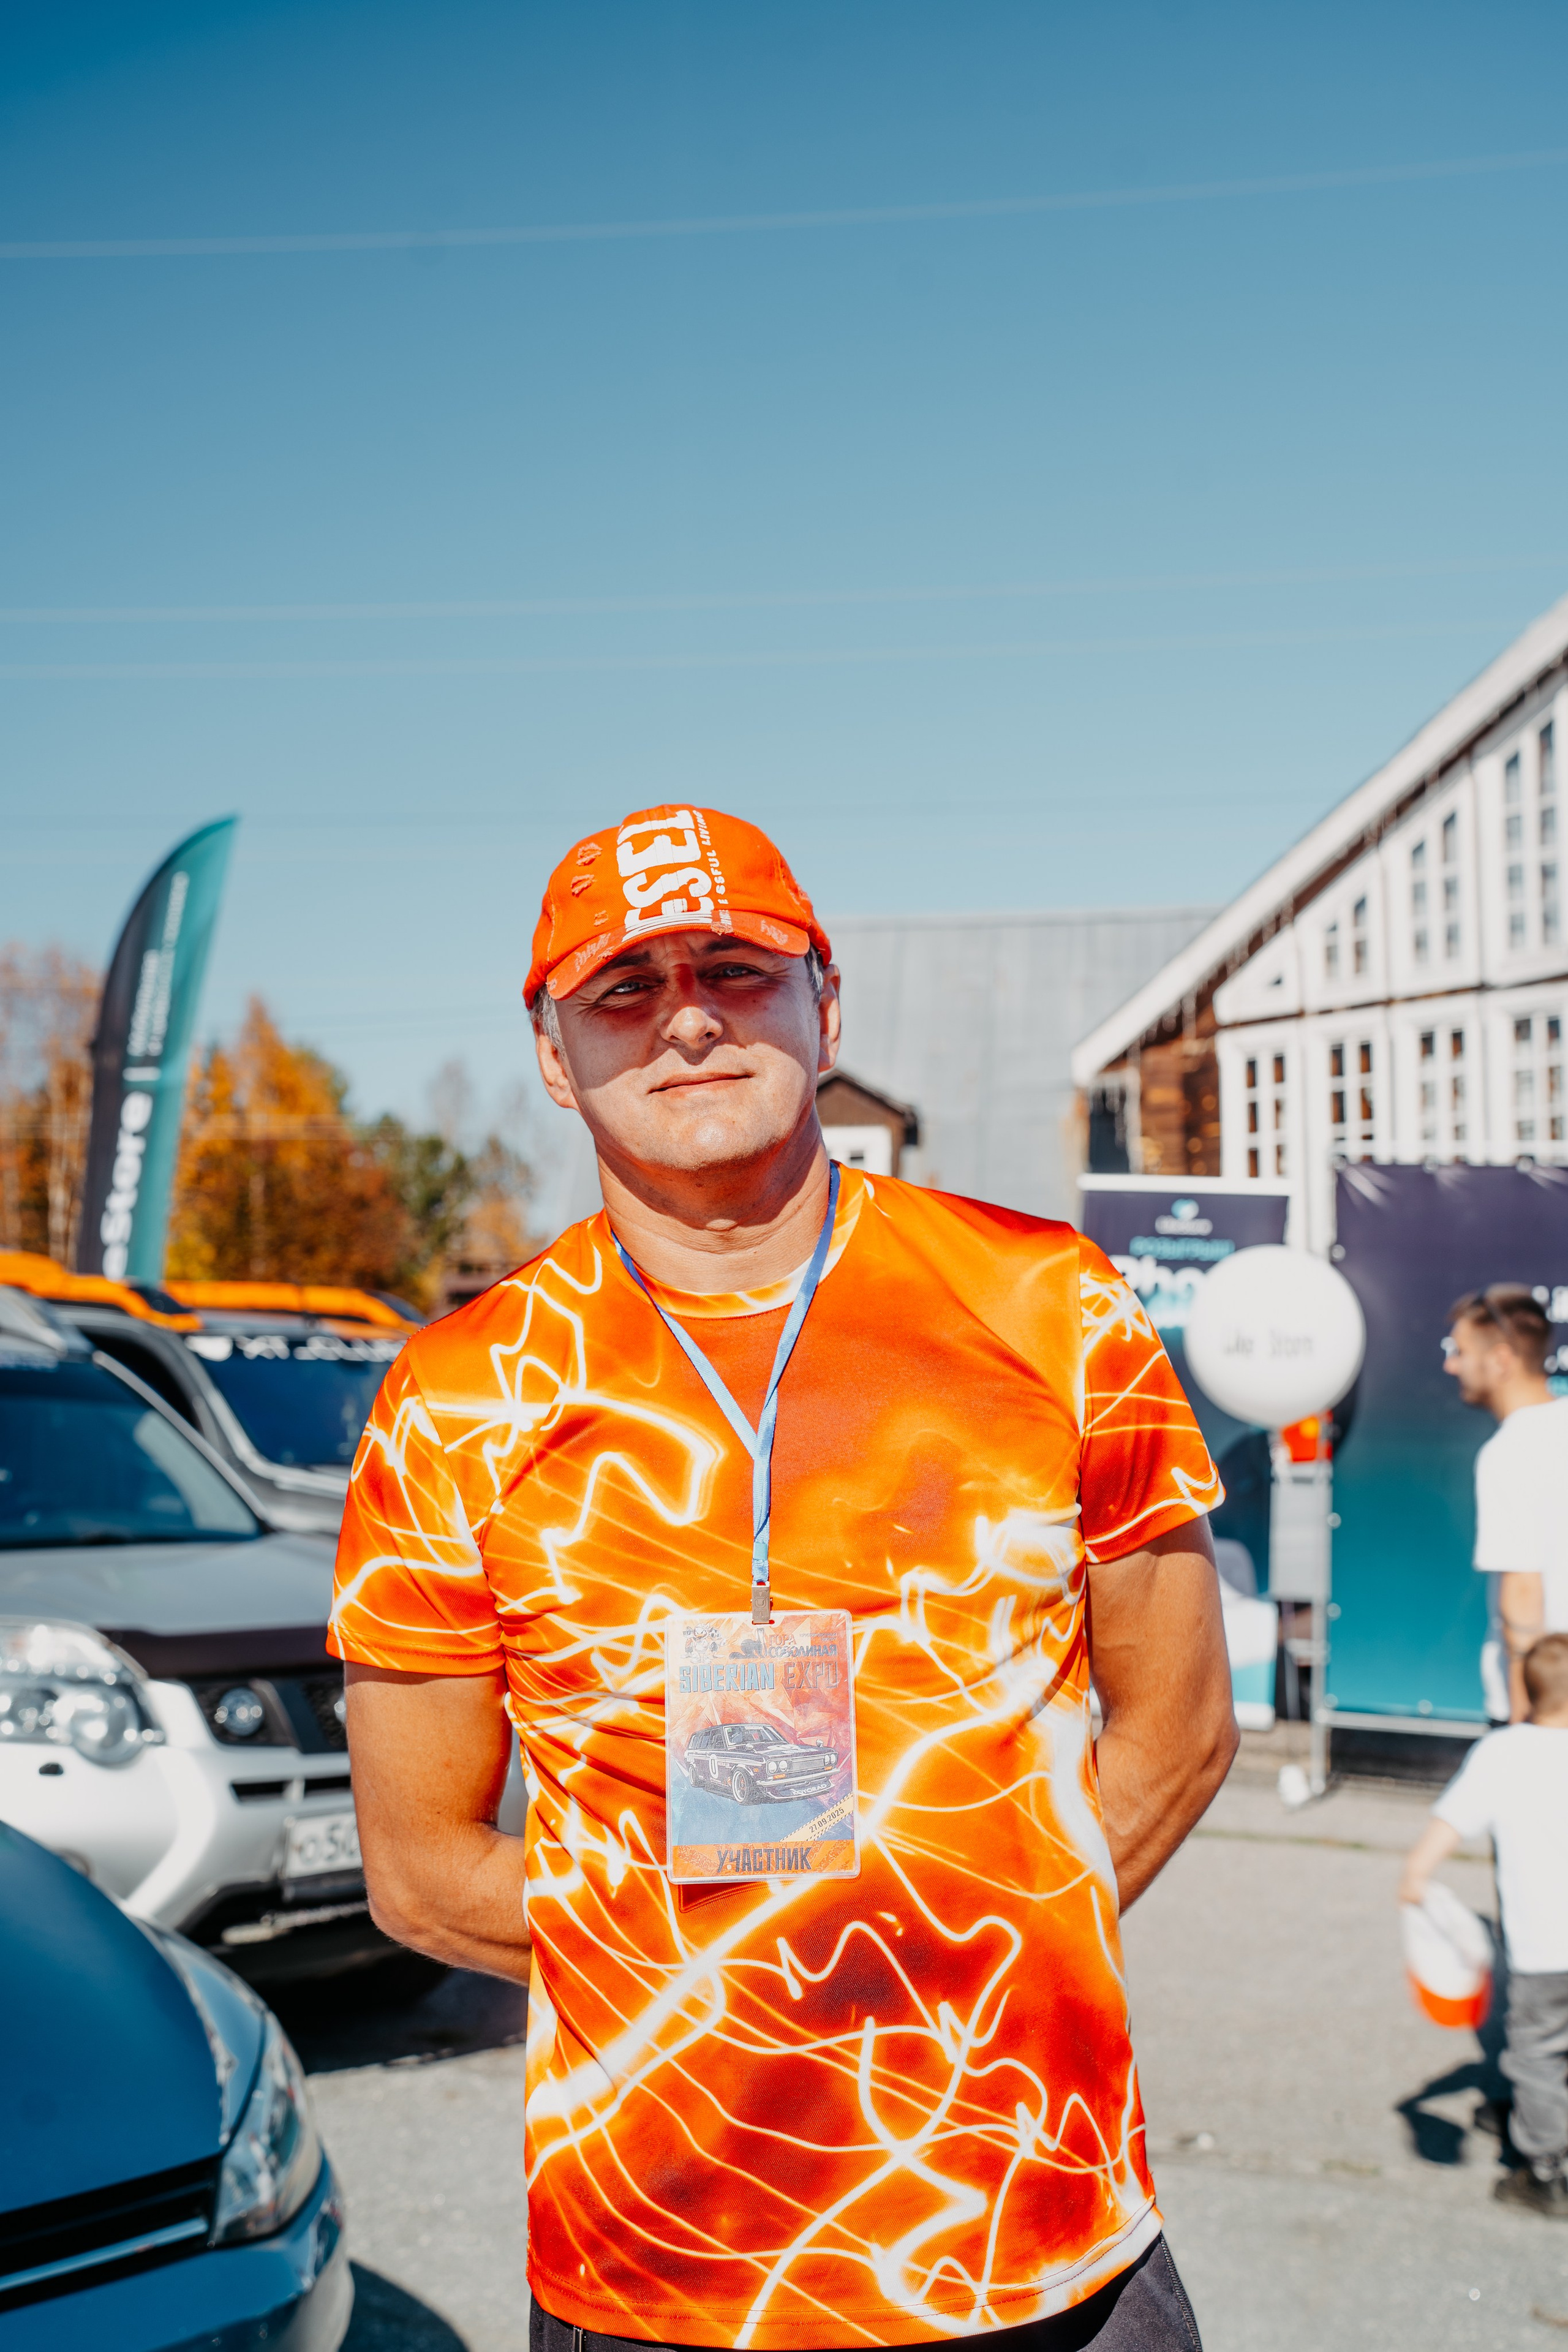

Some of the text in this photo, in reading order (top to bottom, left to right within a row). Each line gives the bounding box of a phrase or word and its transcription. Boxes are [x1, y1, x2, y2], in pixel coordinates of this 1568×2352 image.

[692, 810, 712, 846] LIVING
[767, 1645, 837, 1658] СОБОЛИНАЯ
[769, 1634, 797, 1646] ГОРА
[679, 1660, 838, 1693] SIBERIAN EXPO
[809, 1807, 845, 1833] 27.09.2025
[717, 1847, 813, 1873] УЧАСТНИК
